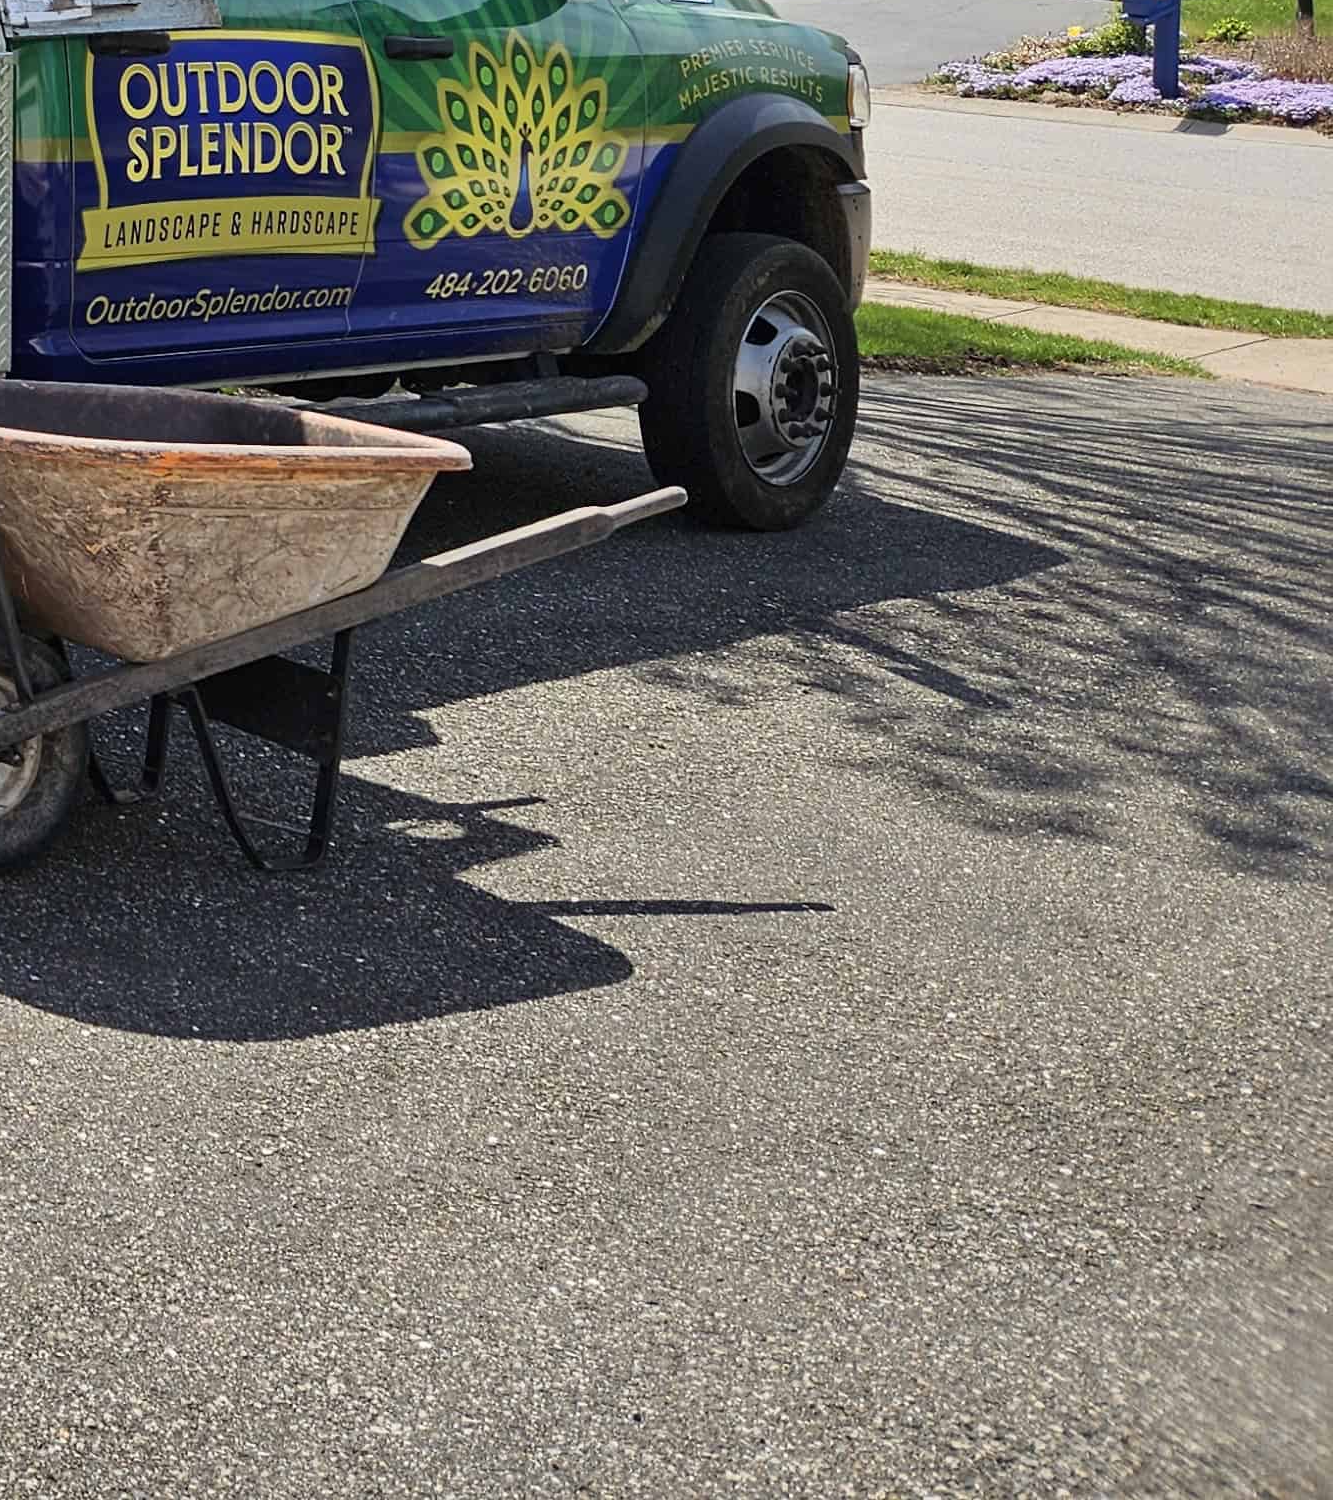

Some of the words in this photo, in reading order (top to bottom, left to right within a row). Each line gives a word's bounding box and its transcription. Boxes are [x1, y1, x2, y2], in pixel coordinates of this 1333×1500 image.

[680, 40, 747, 79] PREMIER
[749, 39, 822, 77] SERVICE,
[119, 60, 349, 119] OUTDOOR
[678, 66, 758, 110] MAJESTIC
[760, 66, 824, 102] RESULTS
[103, 212, 222, 249] LANDSCAPE
[232, 211, 241, 236] &
[251, 210, 359, 236] HARDSCAPE
[85, 284, 353, 326] OutdoorSplendor.com
